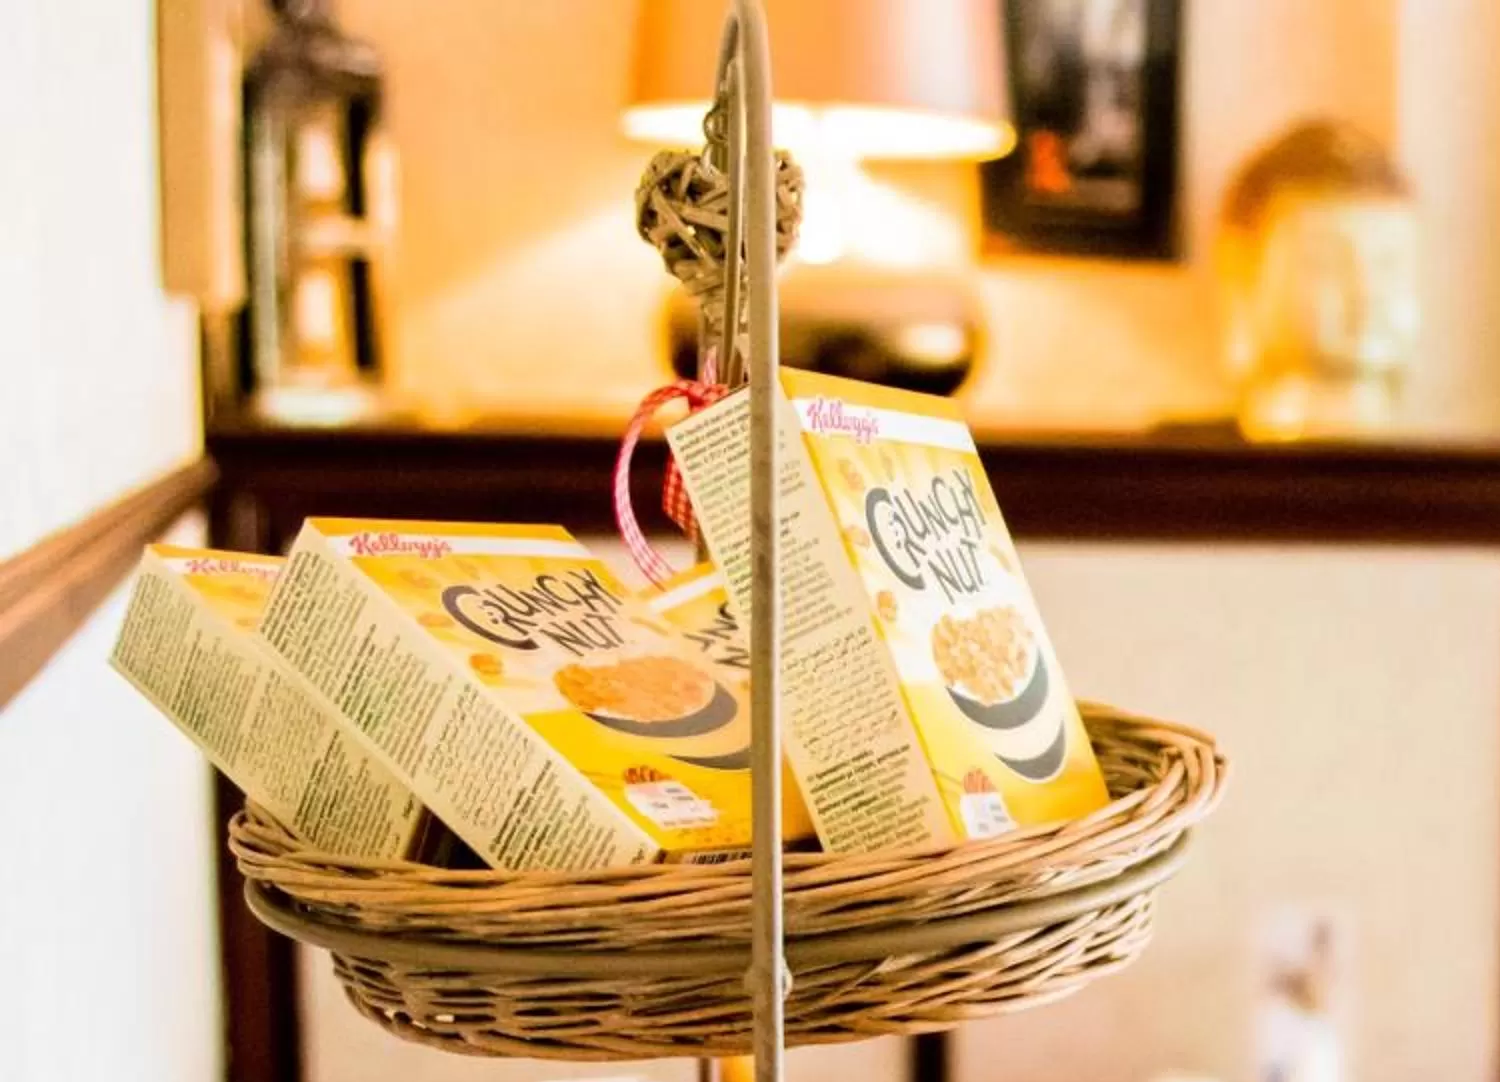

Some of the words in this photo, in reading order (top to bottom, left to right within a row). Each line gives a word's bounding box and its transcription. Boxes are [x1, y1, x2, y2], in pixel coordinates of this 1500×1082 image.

[806, 397, 880, 444] Kellogg's
[349, 533, 452, 559] Kellogg's
[865, 467, 988, 590] CRUNCHY
[927, 537, 985, 605] NUT
[441, 567, 624, 651] CRUNCHY
[538, 612, 625, 657] NUT
